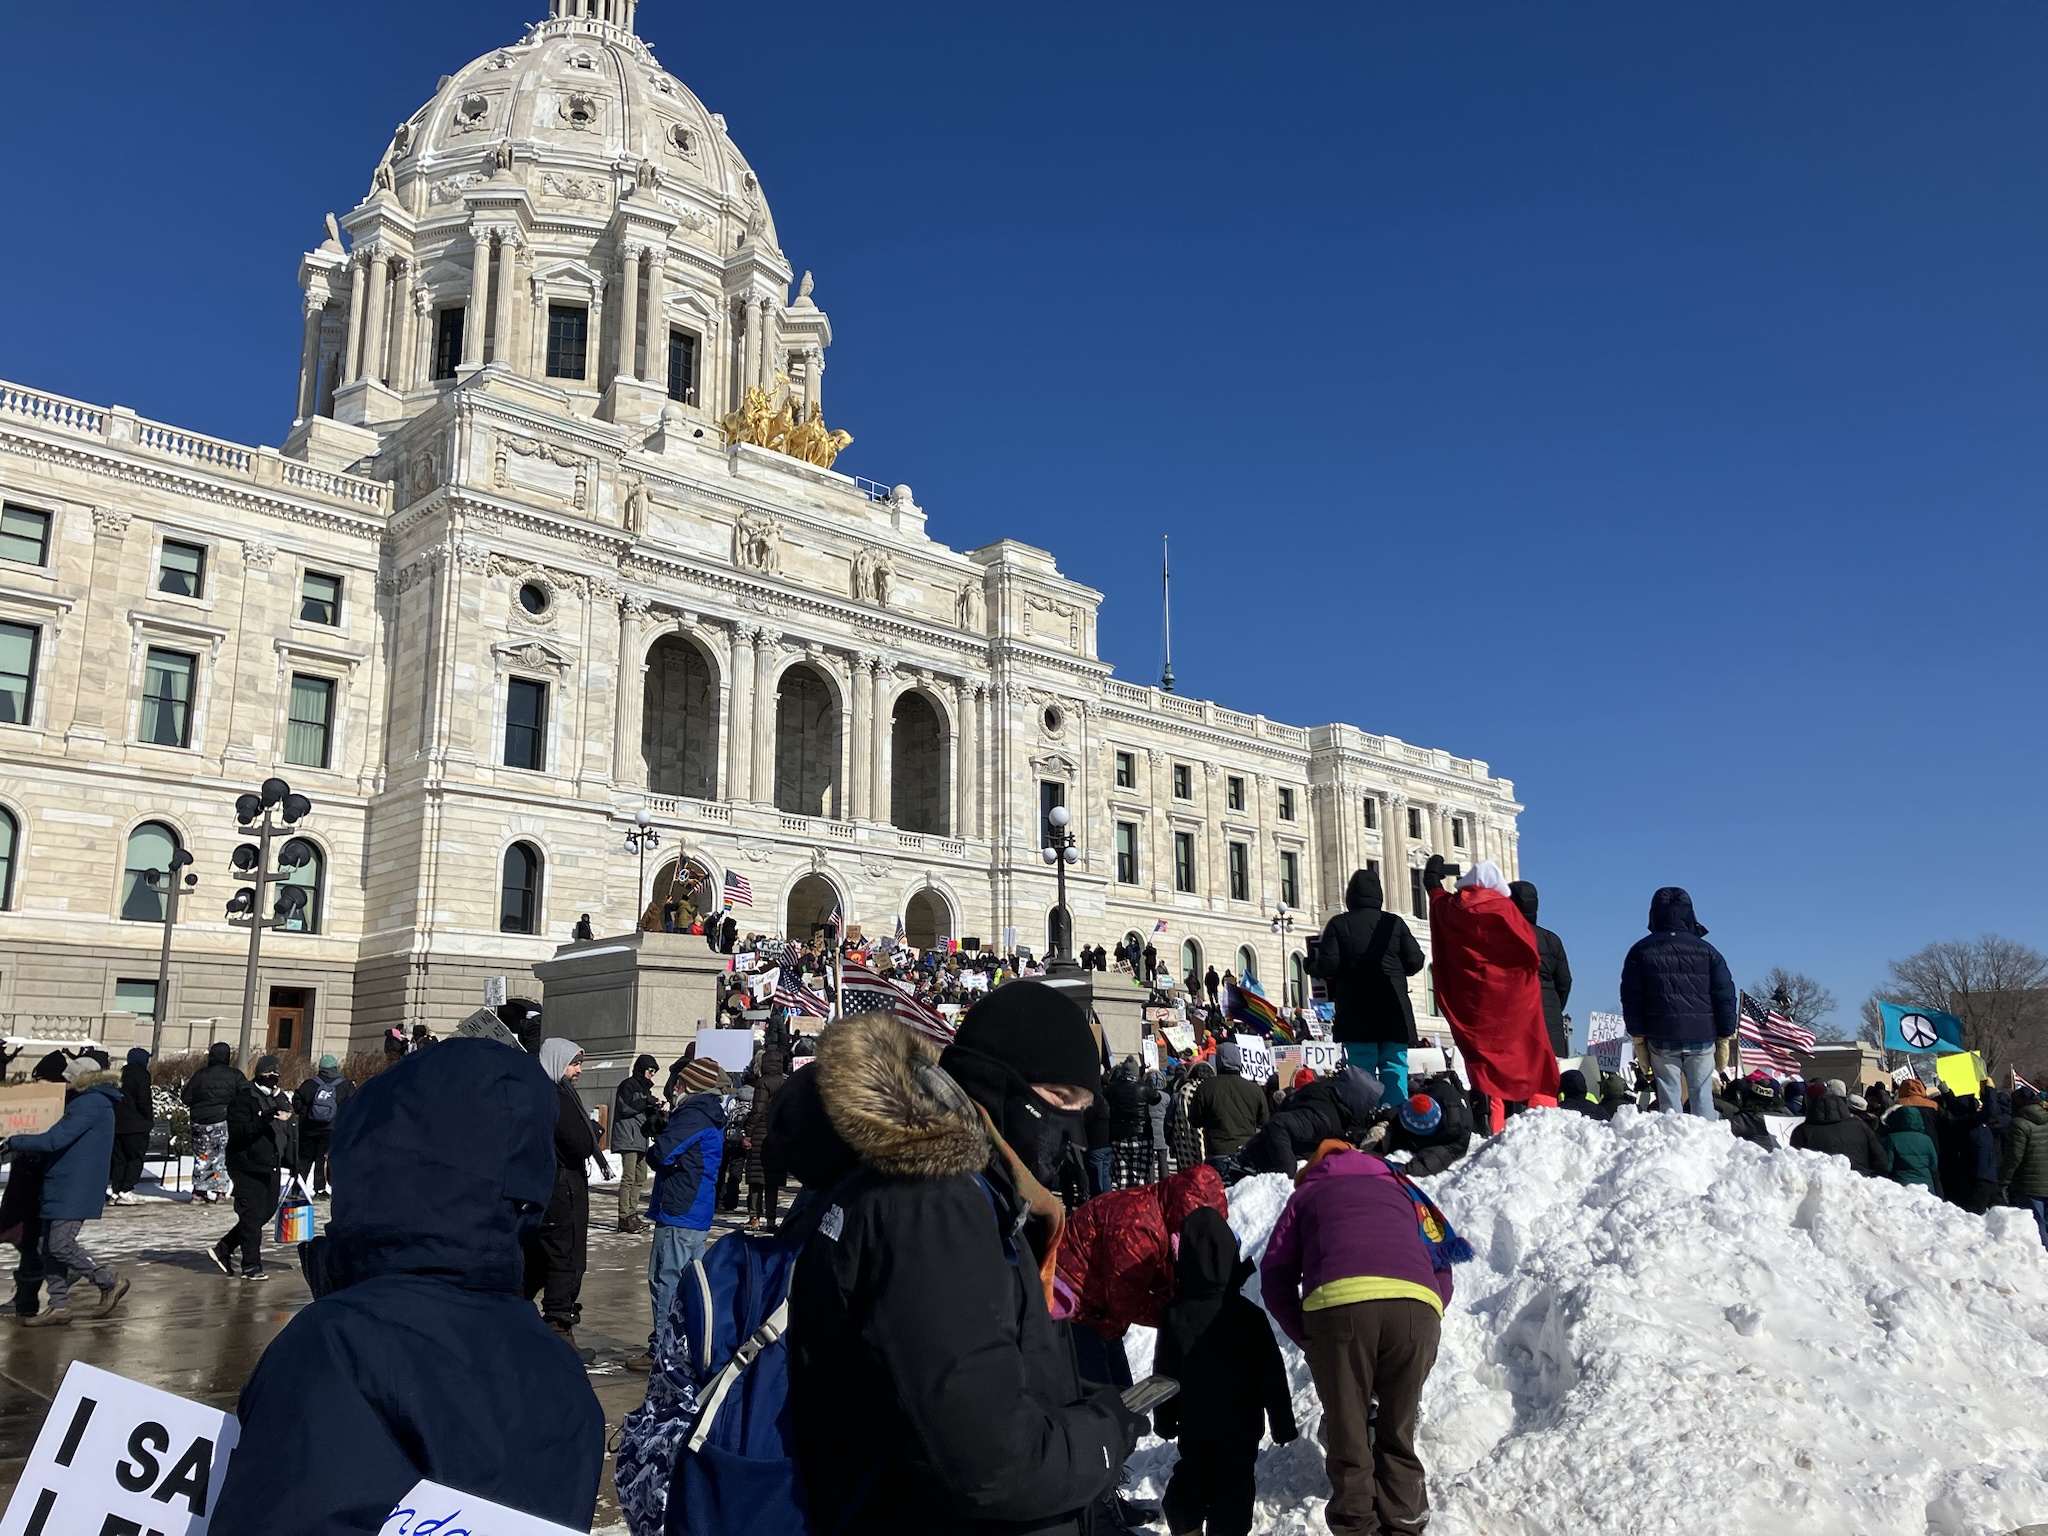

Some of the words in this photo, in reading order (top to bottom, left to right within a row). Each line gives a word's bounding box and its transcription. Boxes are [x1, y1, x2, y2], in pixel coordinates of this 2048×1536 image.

[1591, 1013, 1622, 1025] WHERE
[1598, 1023, 1617, 1031] LAW
[1592, 1030, 1618, 1041] ENDS
[1241, 1047, 1270, 1065] ELON
[1305, 1046, 1335, 1065] FDT
[1597, 1055, 1619, 1067] GINS
[1240, 1063, 1271, 1080] MUSK
[54, 1396, 98, 1468] I
